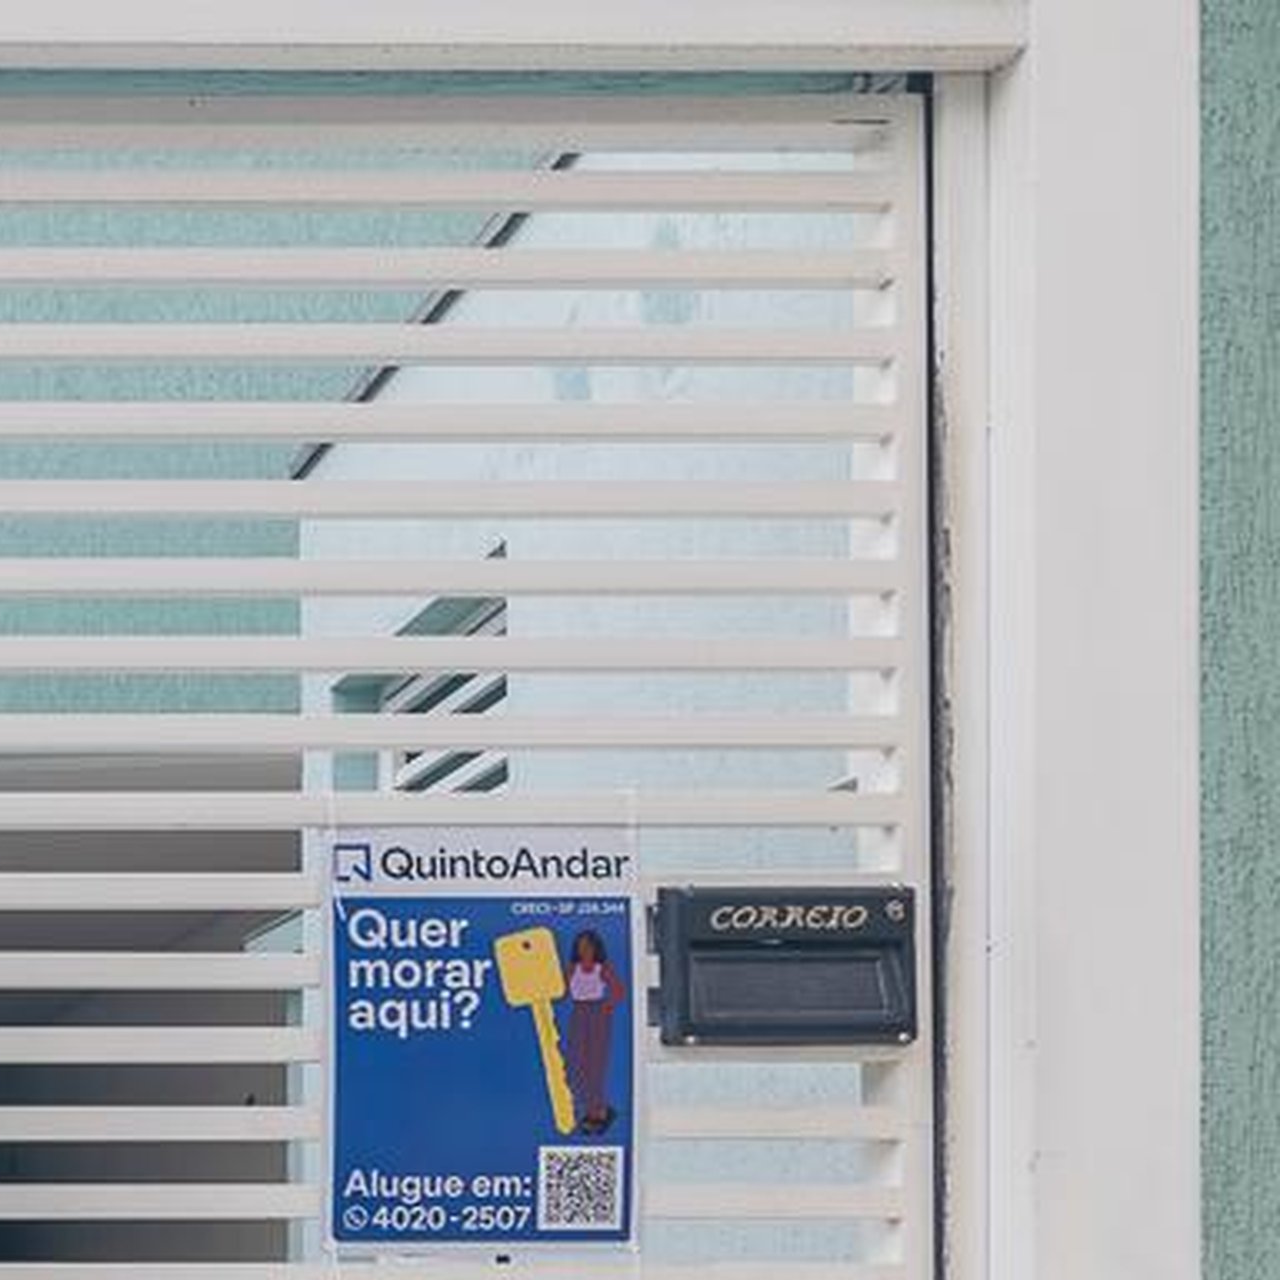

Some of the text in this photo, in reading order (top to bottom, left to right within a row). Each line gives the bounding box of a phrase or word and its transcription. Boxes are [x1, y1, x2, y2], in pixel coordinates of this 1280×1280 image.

[380, 846, 630, 881] QuintoAndar
[348, 908, 469, 949] Quer
[709, 904, 868, 930] CORREIO
[348, 957, 492, 988] morar
[348, 988, 480, 1039] aqui?
[343, 1168, 533, 1205] Alugue em:
[371, 1205, 532, 1231] 4020-2507
